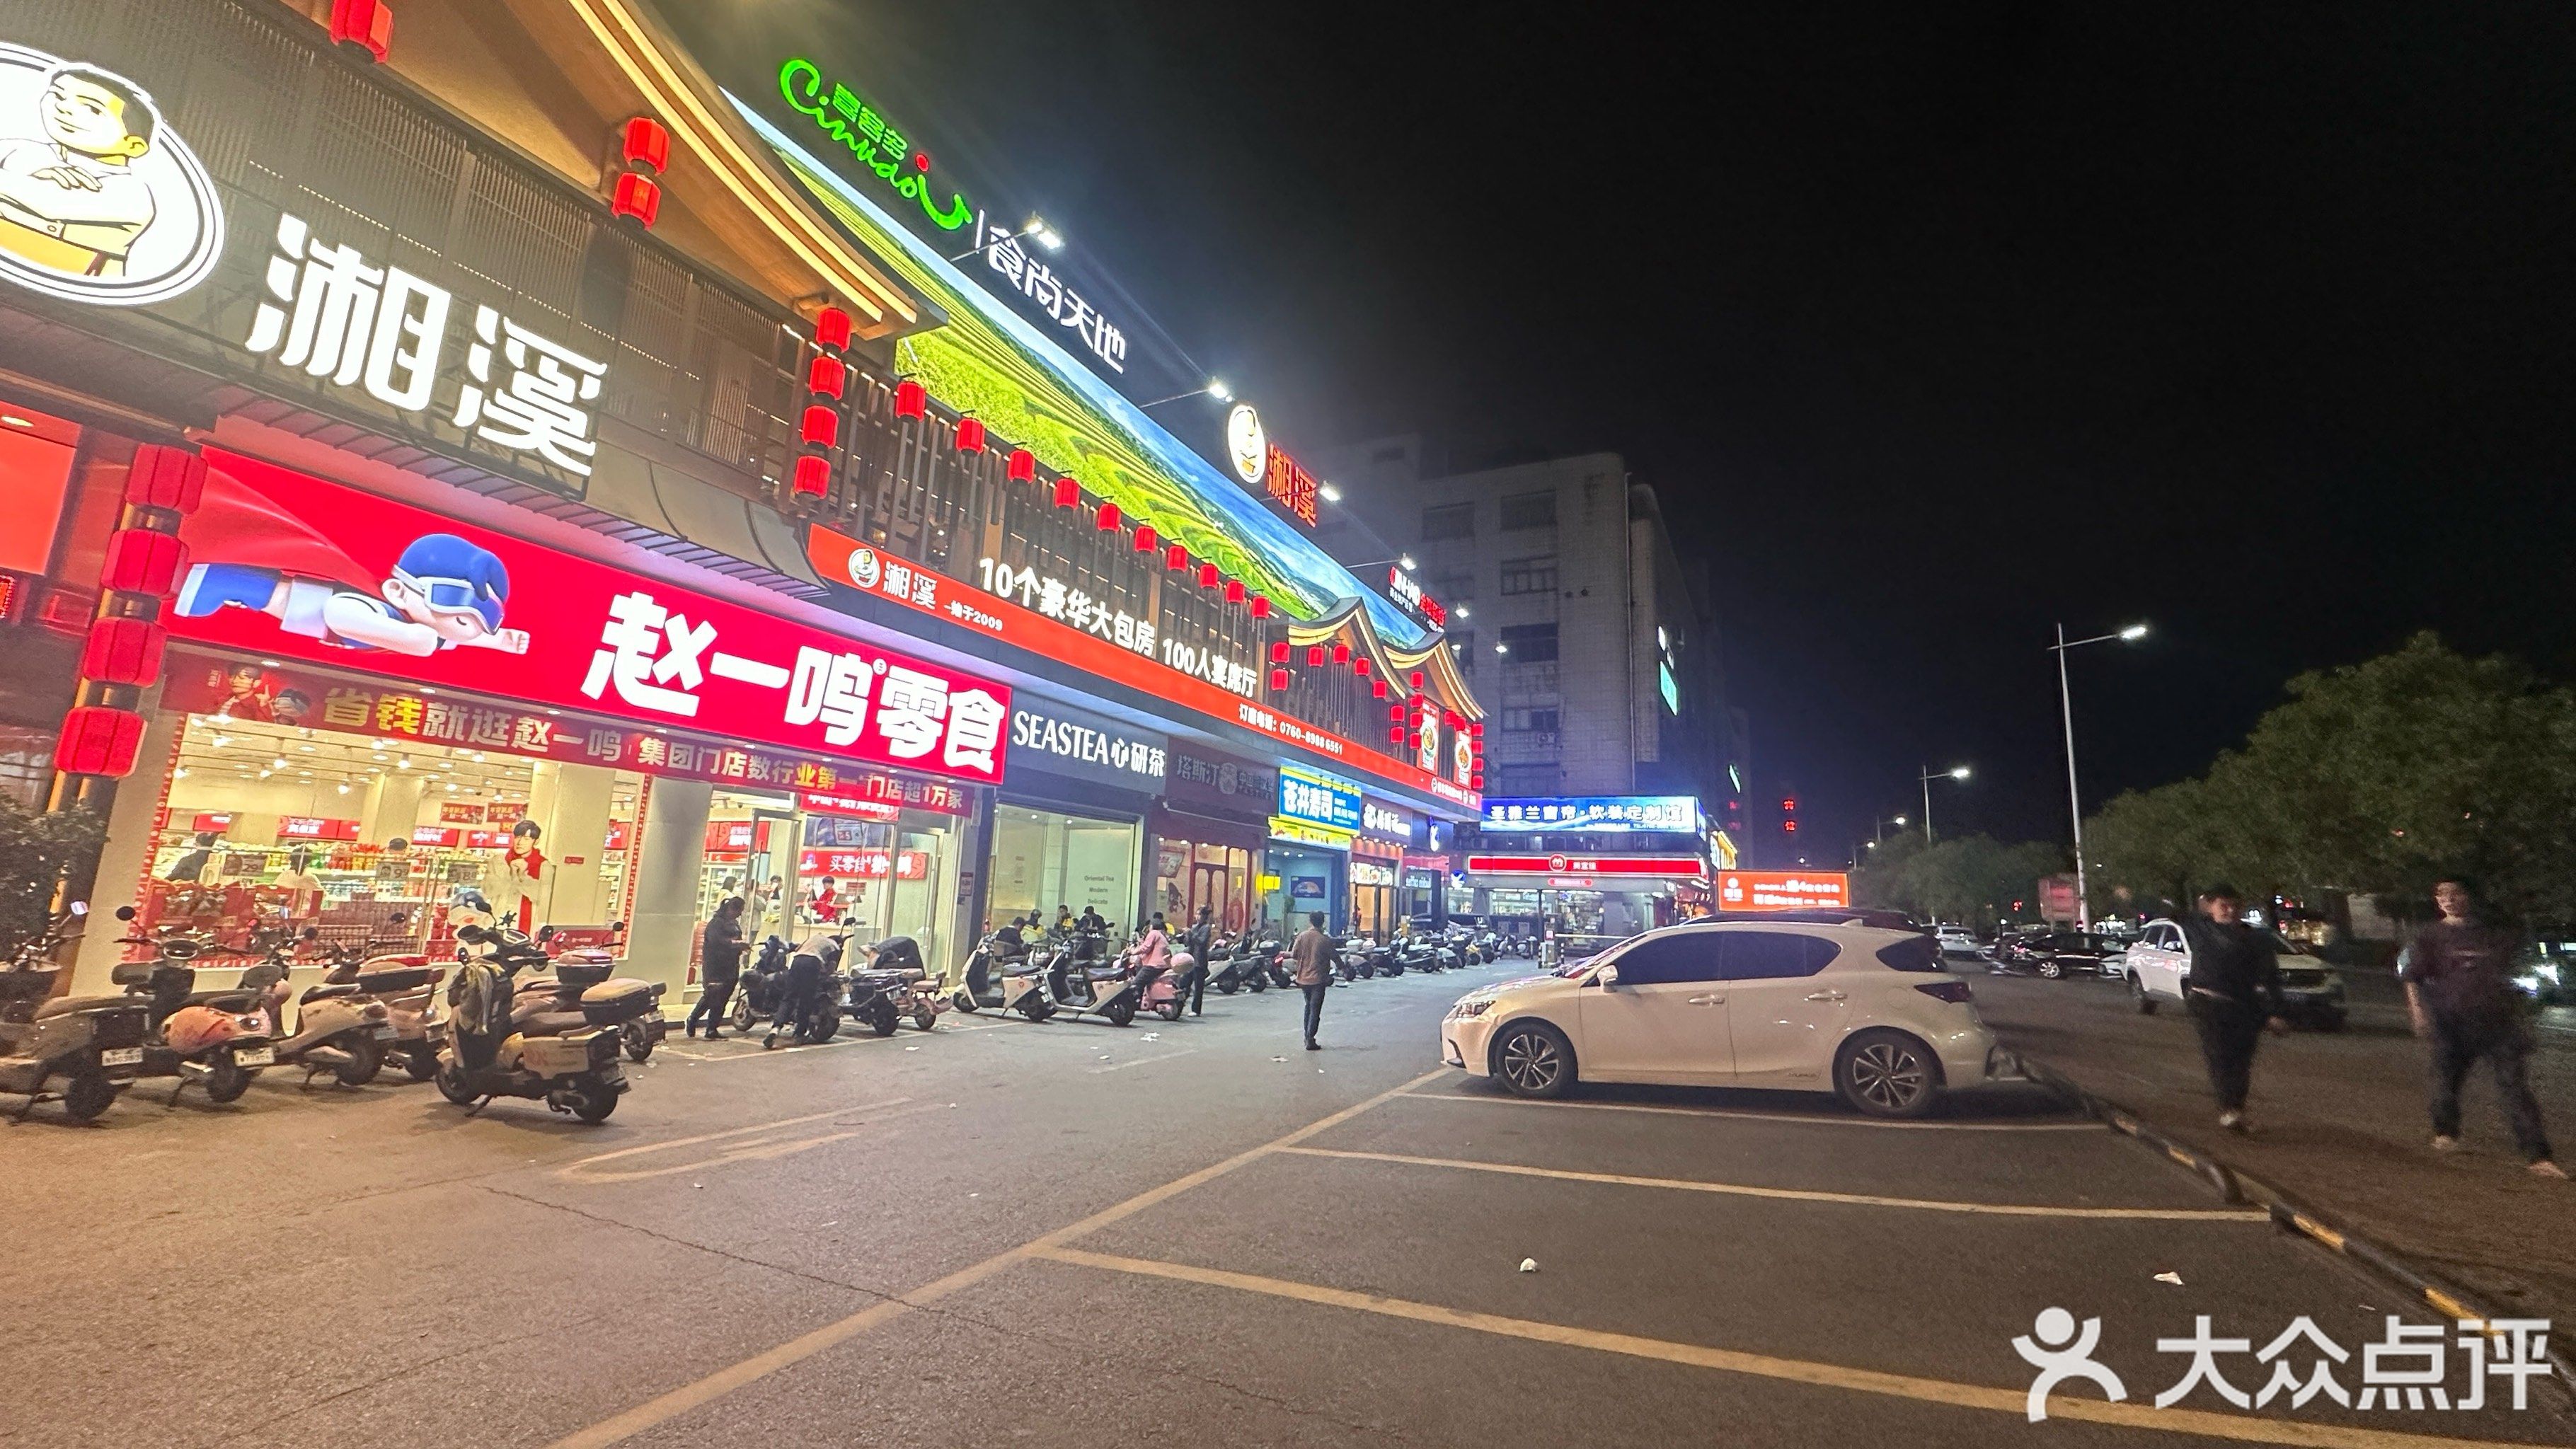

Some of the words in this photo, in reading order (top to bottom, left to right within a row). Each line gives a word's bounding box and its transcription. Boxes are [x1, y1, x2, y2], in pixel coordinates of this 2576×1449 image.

[988, 226, 1127, 374] 食尚天地
[245, 212, 608, 477] 湘溪
[1267, 442, 1318, 528] 湘溪
[882, 560, 938, 610] 湘溪
[979, 557, 1156, 658] 10个豪华大包房
[1162, 638, 1258, 698] 100人宴席厅
[323, 687, 623, 762] 省钱就逛赵一鸣
[1013, 710, 1109, 765] SEASTEA
[1111, 737, 1166, 778] 心研茶
[1176, 754, 1219, 787] 塔斯汀
[1283, 779, 1334, 821] 苍井寿司
